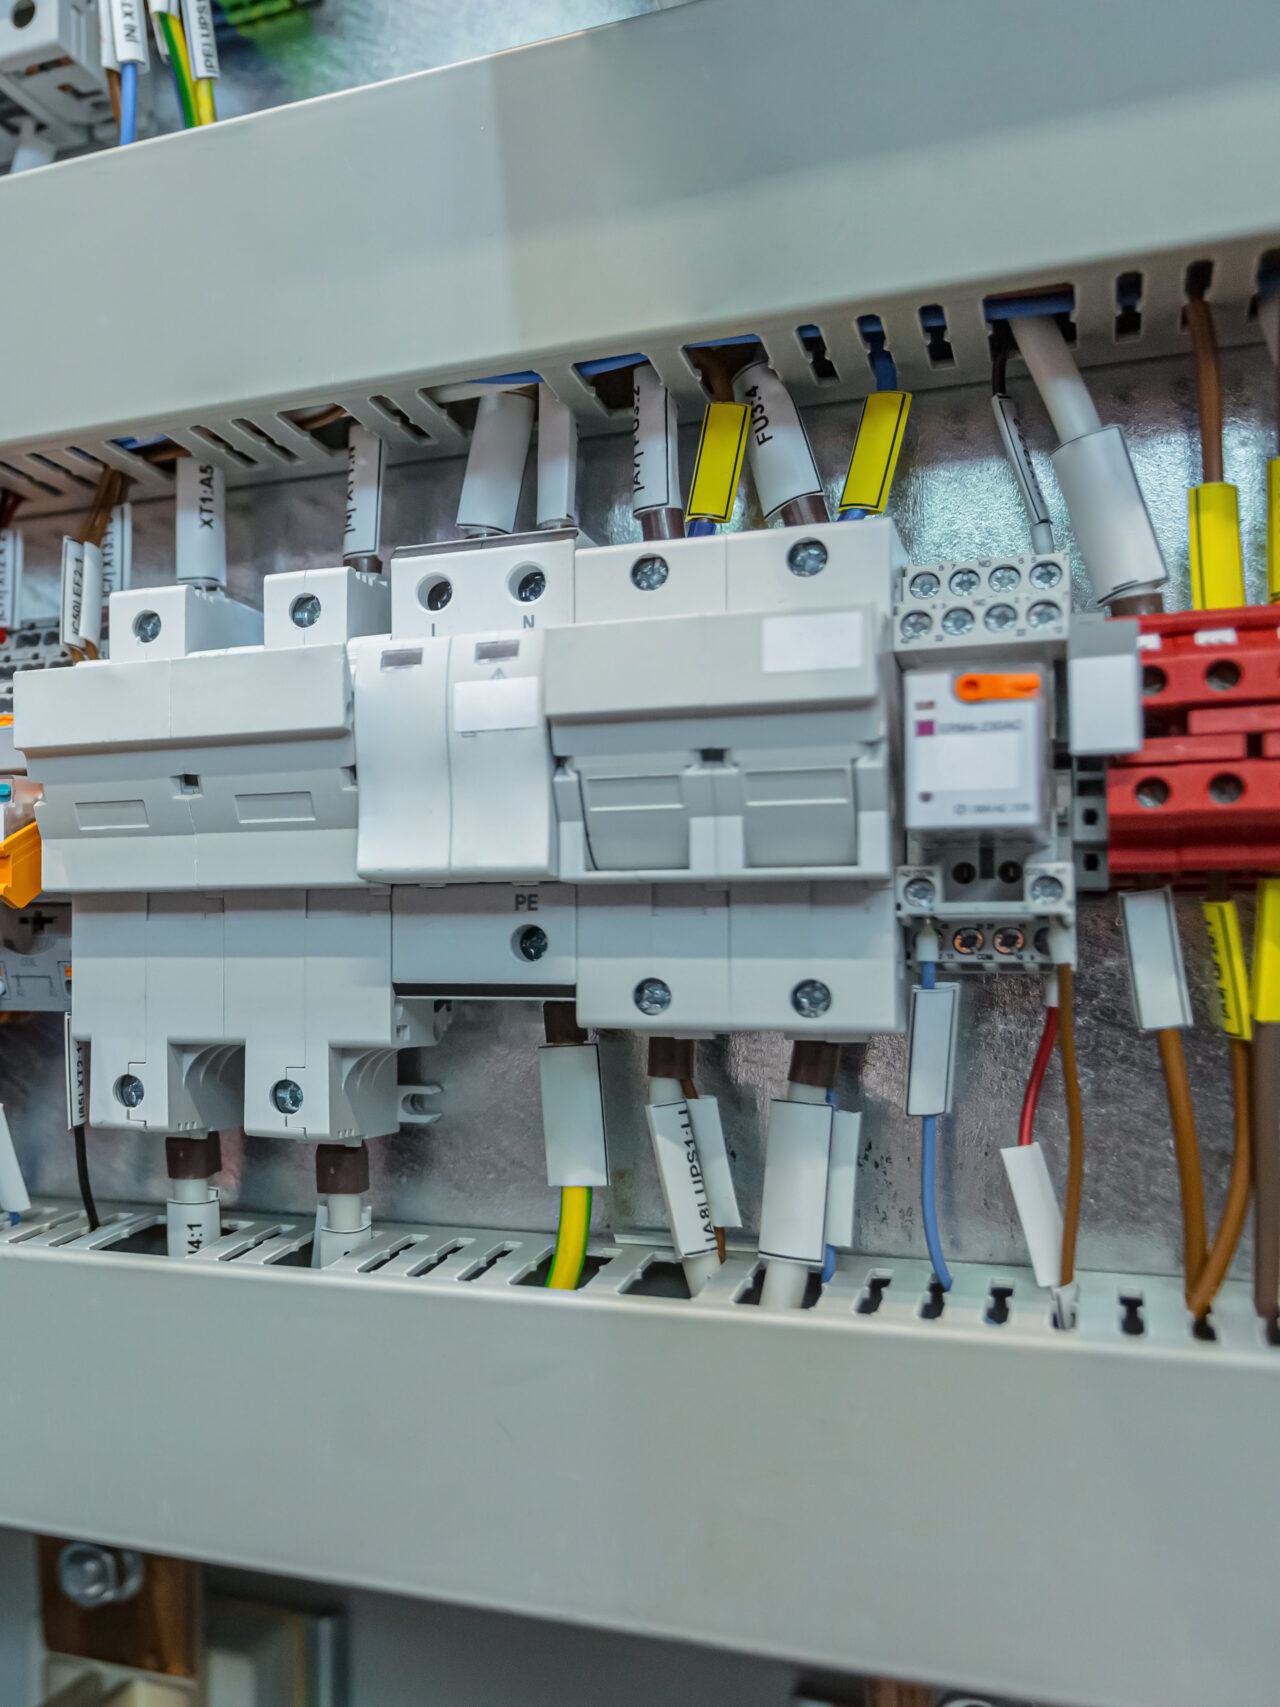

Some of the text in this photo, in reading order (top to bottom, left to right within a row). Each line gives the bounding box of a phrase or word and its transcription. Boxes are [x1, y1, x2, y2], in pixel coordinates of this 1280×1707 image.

[745, 385, 773, 447] FU3:4
[199, 464, 214, 530] XT1:A5
[522, 614, 536, 629] N
[514, 893, 539, 912] PE
